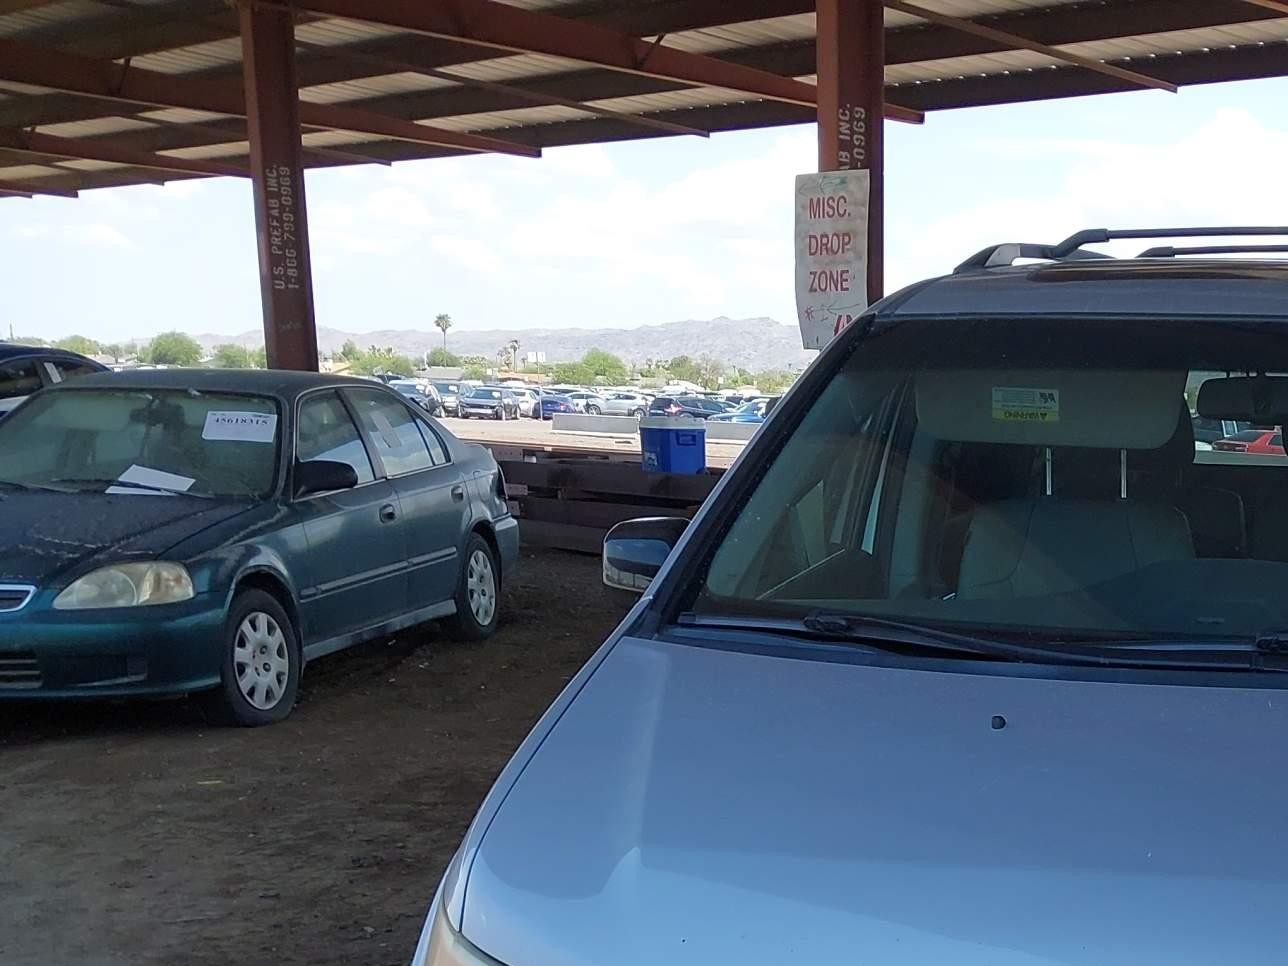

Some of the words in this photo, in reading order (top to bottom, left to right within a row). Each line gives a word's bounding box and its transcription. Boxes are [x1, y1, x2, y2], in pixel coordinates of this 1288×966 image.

[838, 103, 851, 141] INC.
[265, 164, 279, 191] INC.
[808, 195, 851, 220] MISC.
[268, 199, 283, 254] PREFAB
[808, 232, 852, 257] DROP
[273, 263, 286, 289] U.S.
[808, 269, 850, 293] ZONE
